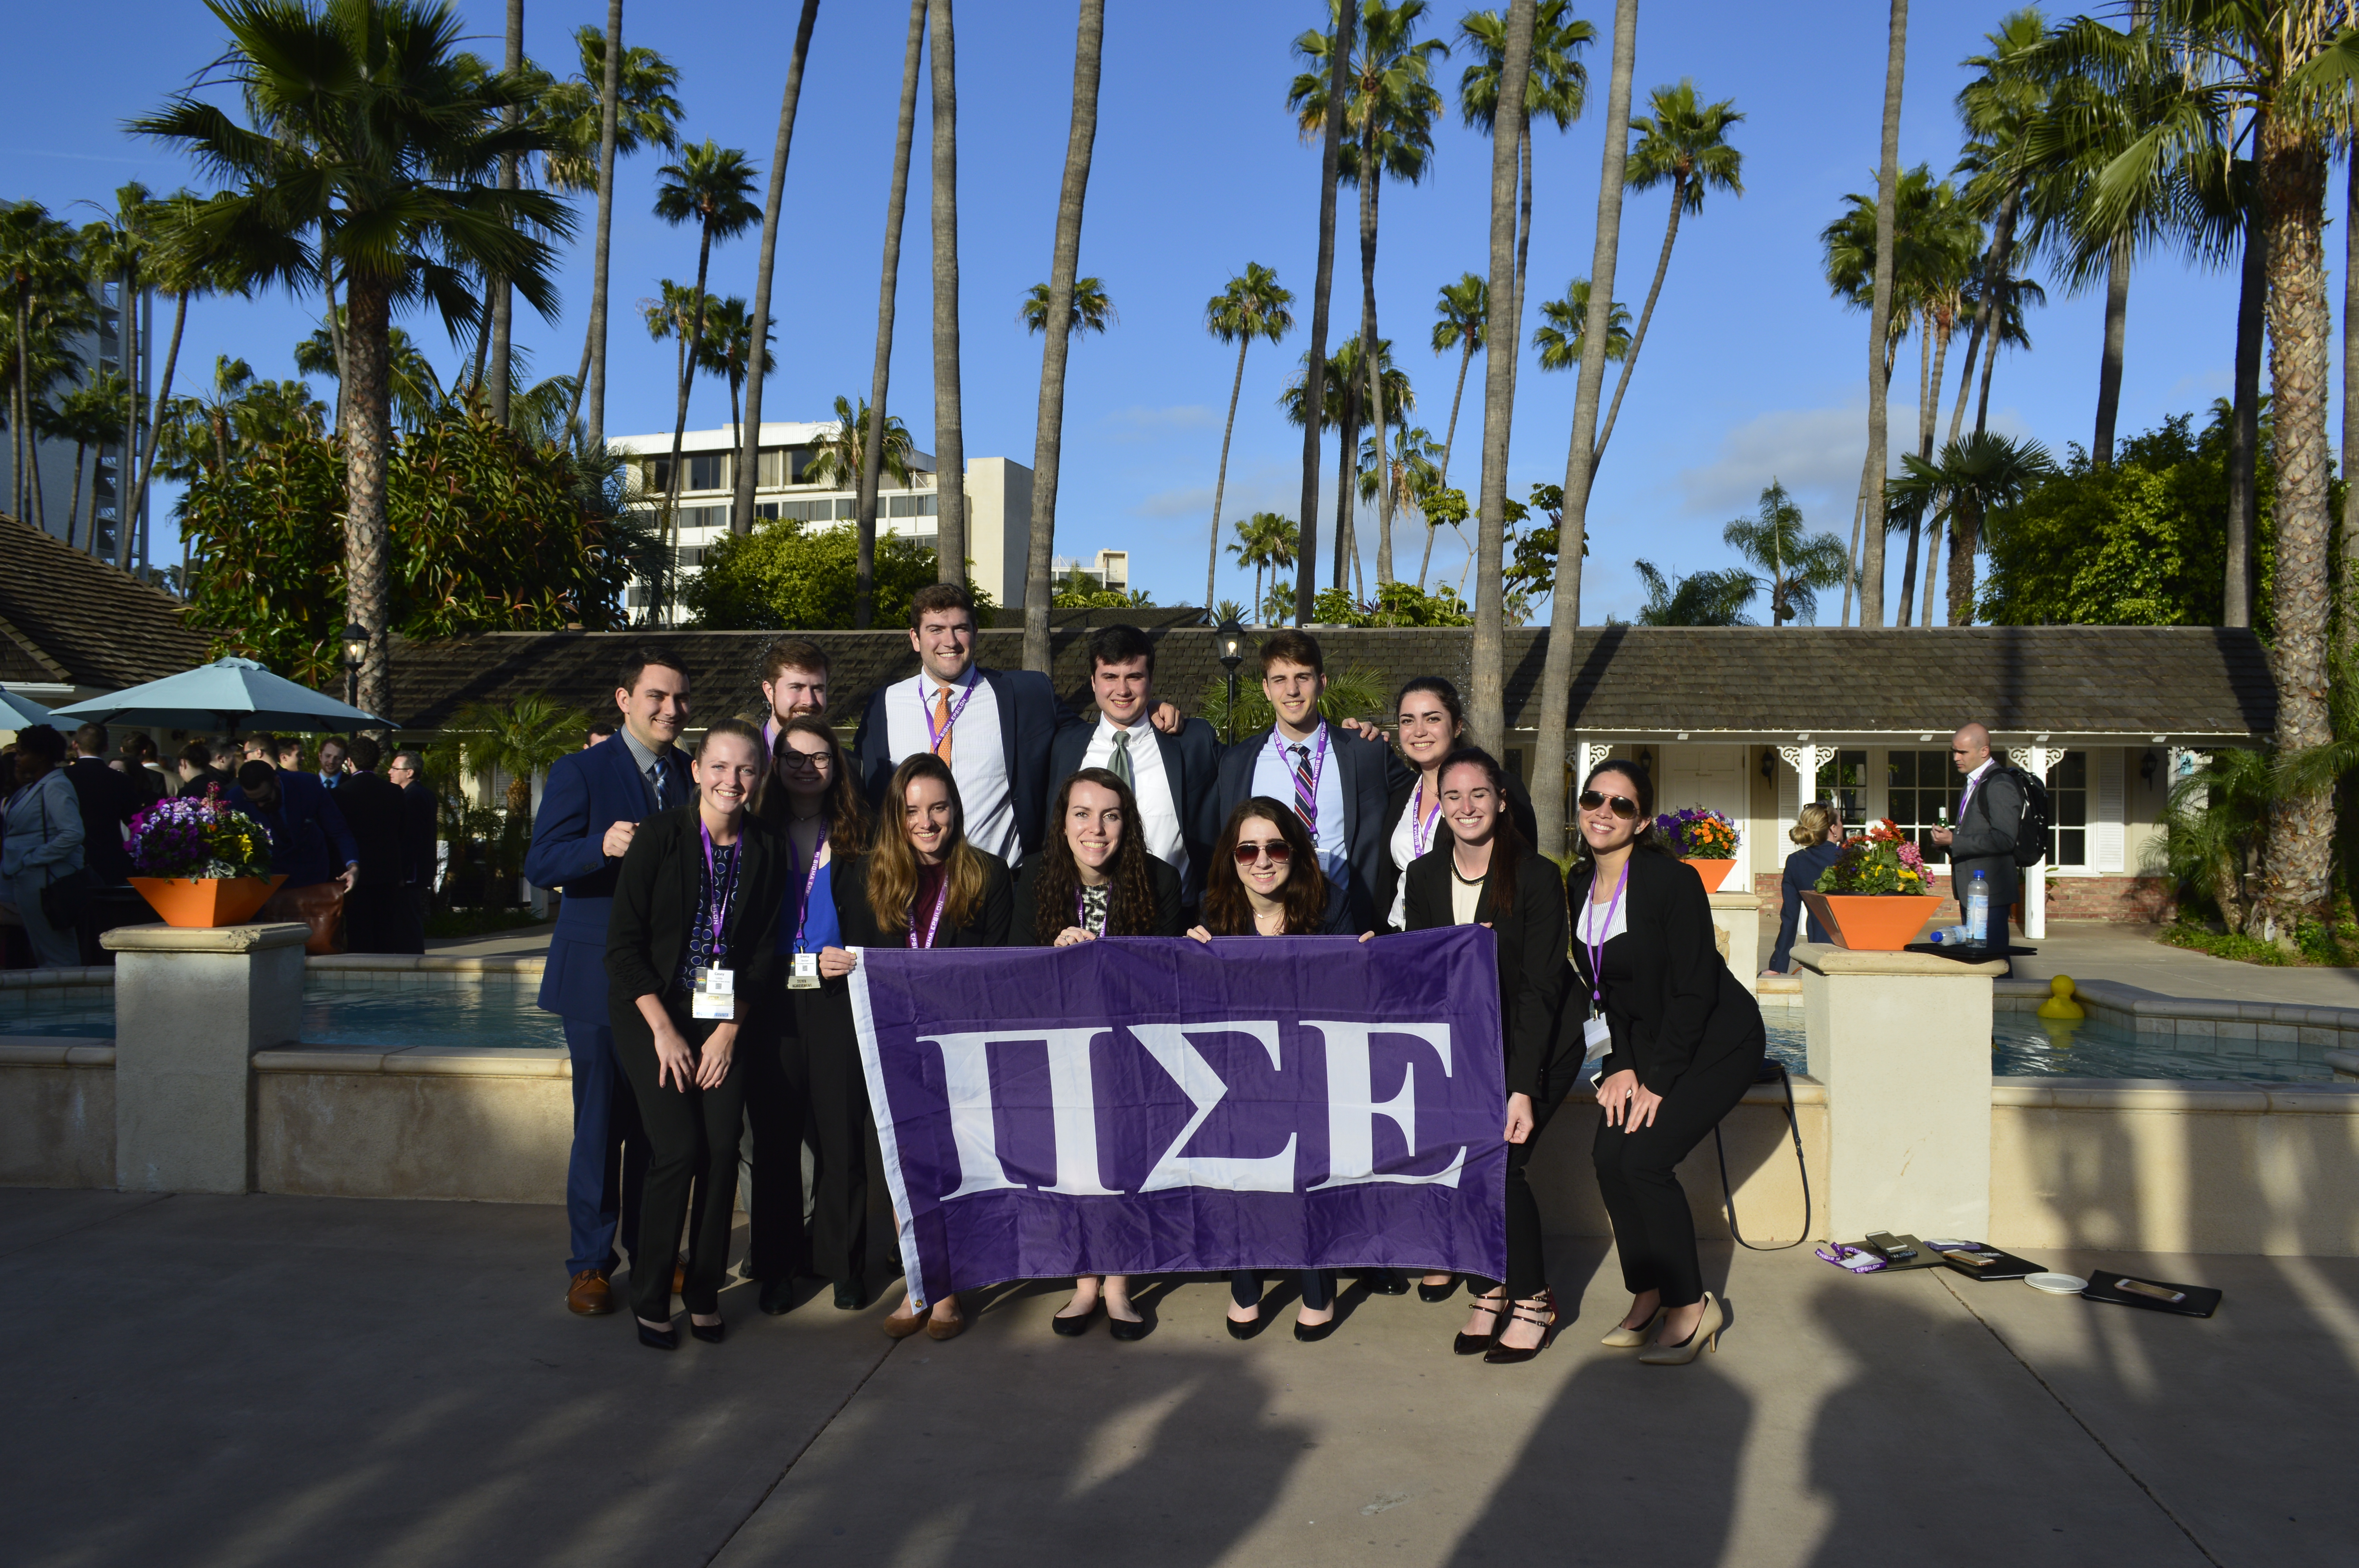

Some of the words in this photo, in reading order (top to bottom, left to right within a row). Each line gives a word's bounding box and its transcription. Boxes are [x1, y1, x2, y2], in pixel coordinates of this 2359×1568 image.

[940, 721, 953, 737] SIGMA
[951, 698, 967, 720] EPSILON
[809, 859, 819, 880] SIGMA
[925, 932, 934, 948] IGMA
[931, 900, 943, 930] EPSILON
[1816, 1250, 1835, 1261] SIGMA
[1856, 1263, 1880, 1272] EPSILON
